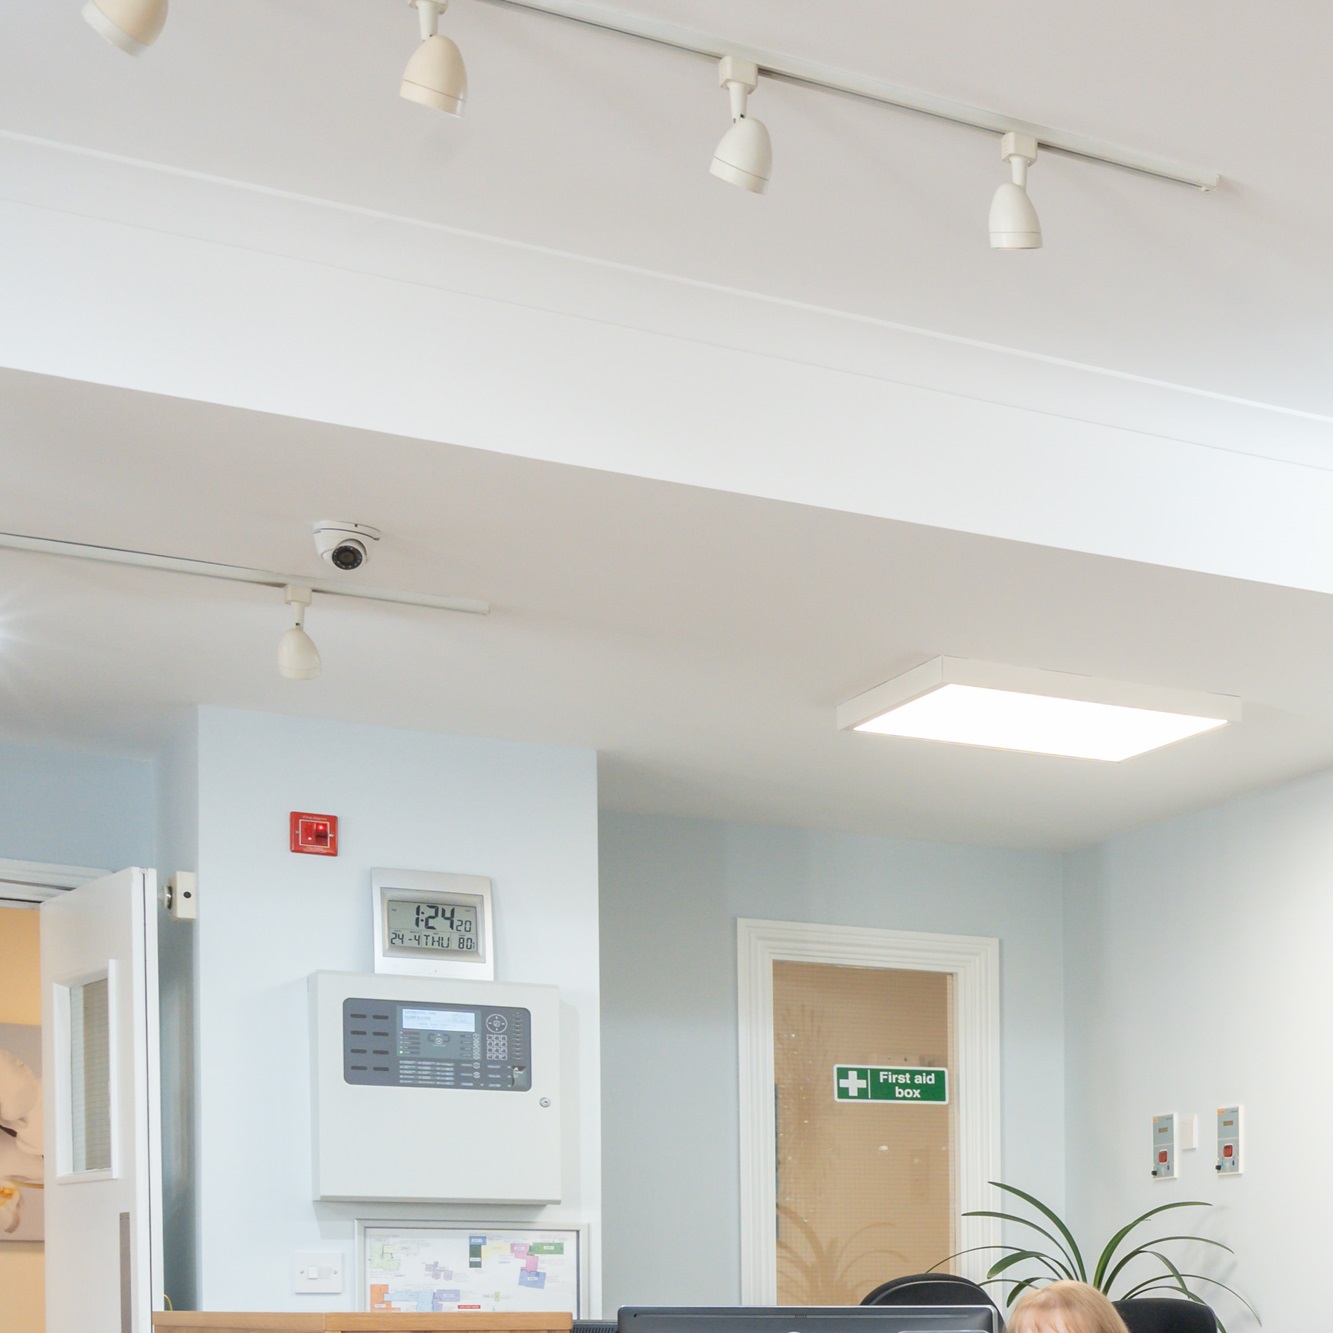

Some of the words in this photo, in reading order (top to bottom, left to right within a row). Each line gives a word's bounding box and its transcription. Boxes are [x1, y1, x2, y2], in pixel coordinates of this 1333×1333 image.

[415, 905, 455, 930] 1:24
[456, 920, 472, 932] 20
[391, 932, 404, 945] 24
[424, 935, 449, 948] THU
[879, 1071, 911, 1084] First
[914, 1073, 935, 1084] aid
[895, 1086, 921, 1098] box
